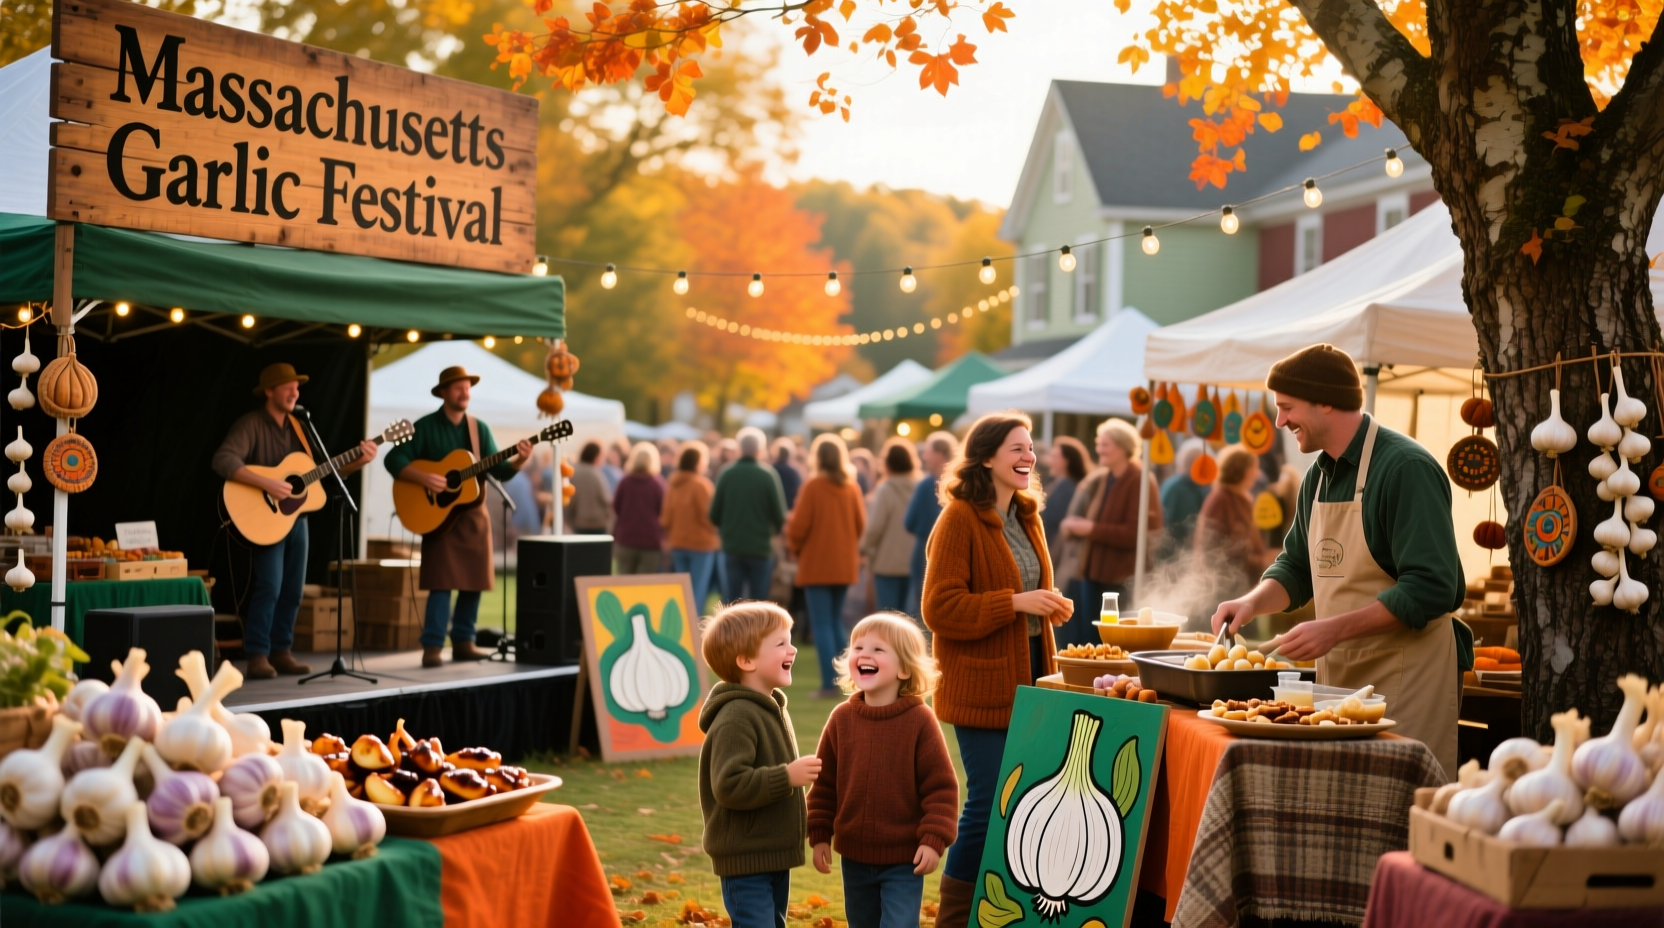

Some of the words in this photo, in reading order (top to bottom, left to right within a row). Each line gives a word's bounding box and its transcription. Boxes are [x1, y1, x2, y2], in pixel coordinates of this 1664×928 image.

[110, 24, 505, 170] Massachusetts
[106, 122, 301, 220] Garlic
[317, 156, 503, 245] Festival
